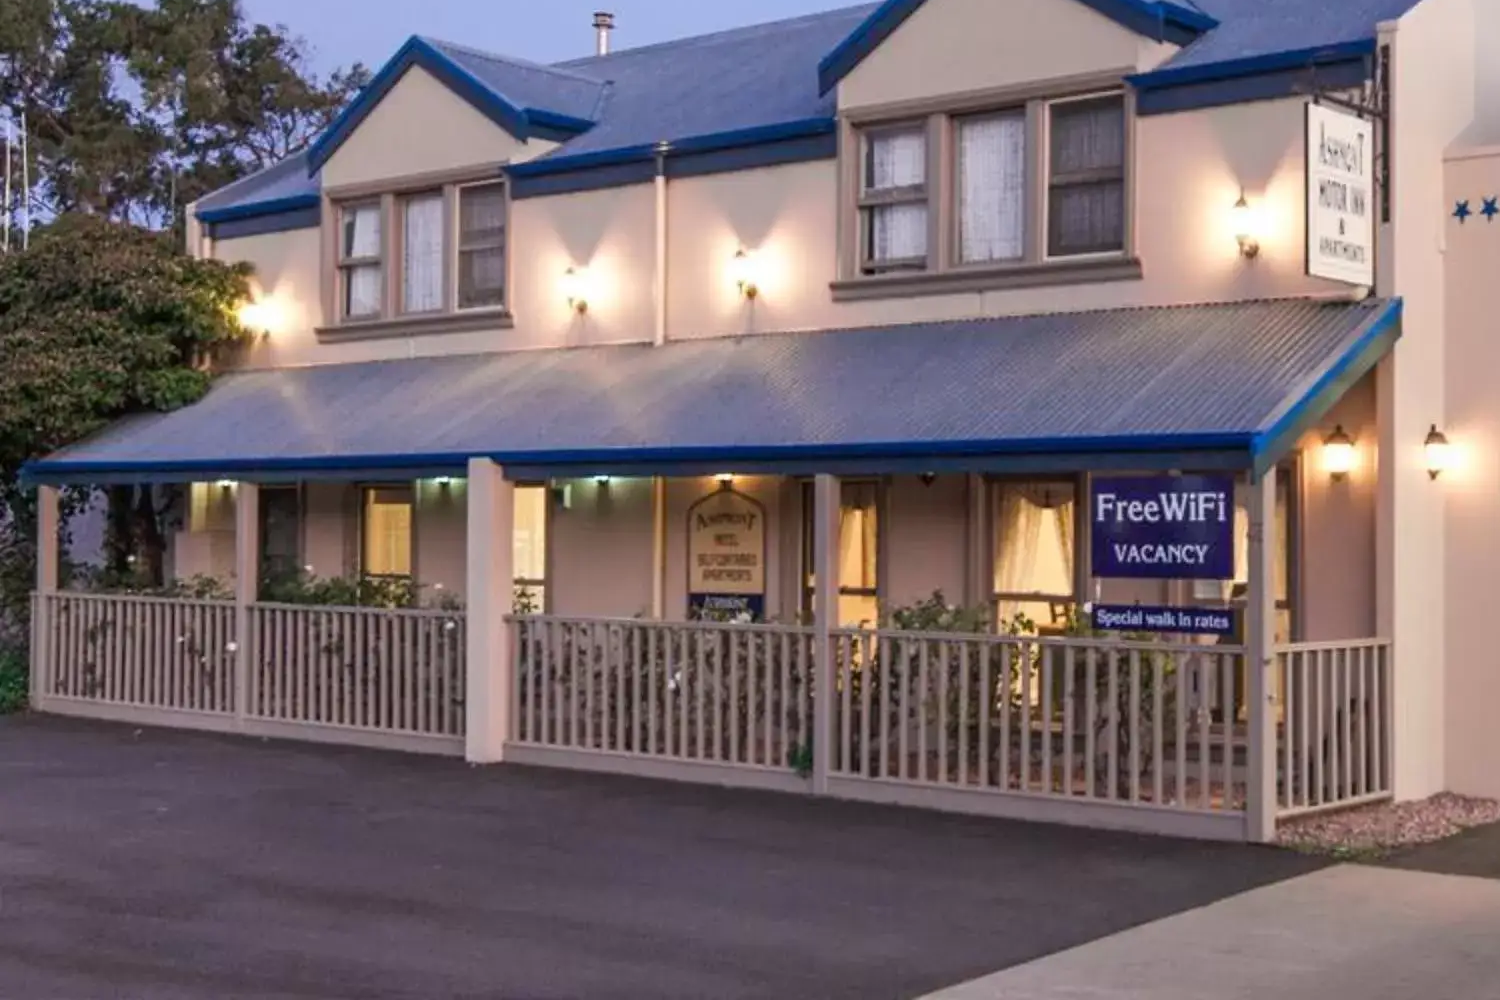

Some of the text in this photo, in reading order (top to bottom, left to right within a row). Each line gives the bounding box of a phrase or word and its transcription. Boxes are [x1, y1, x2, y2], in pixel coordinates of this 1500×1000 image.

[1113, 543, 1209, 564] VACANCY
[1097, 610, 1229, 629] Special walk in rates
